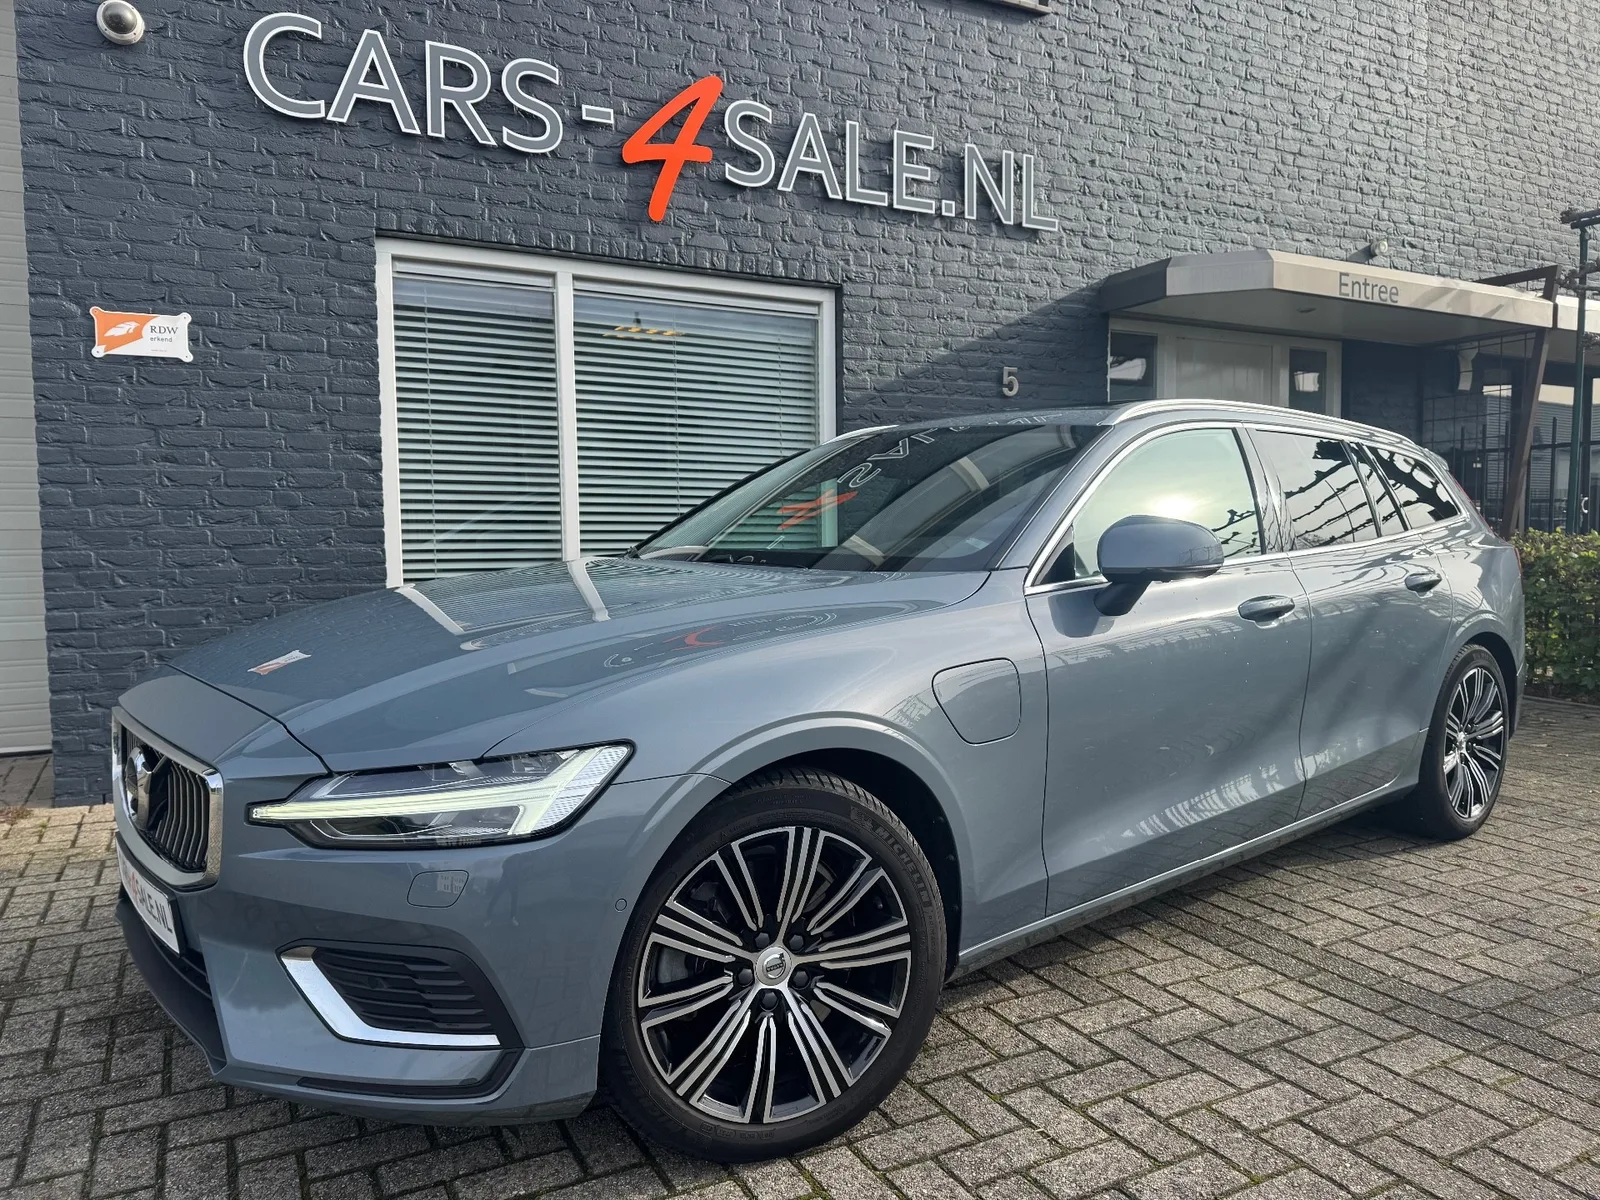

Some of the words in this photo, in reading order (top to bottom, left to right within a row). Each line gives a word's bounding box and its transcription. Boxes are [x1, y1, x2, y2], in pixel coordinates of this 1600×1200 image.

[1338, 271, 1399, 304] Entree
[150, 325, 179, 335] RDW
[1002, 366, 1019, 397] 5
